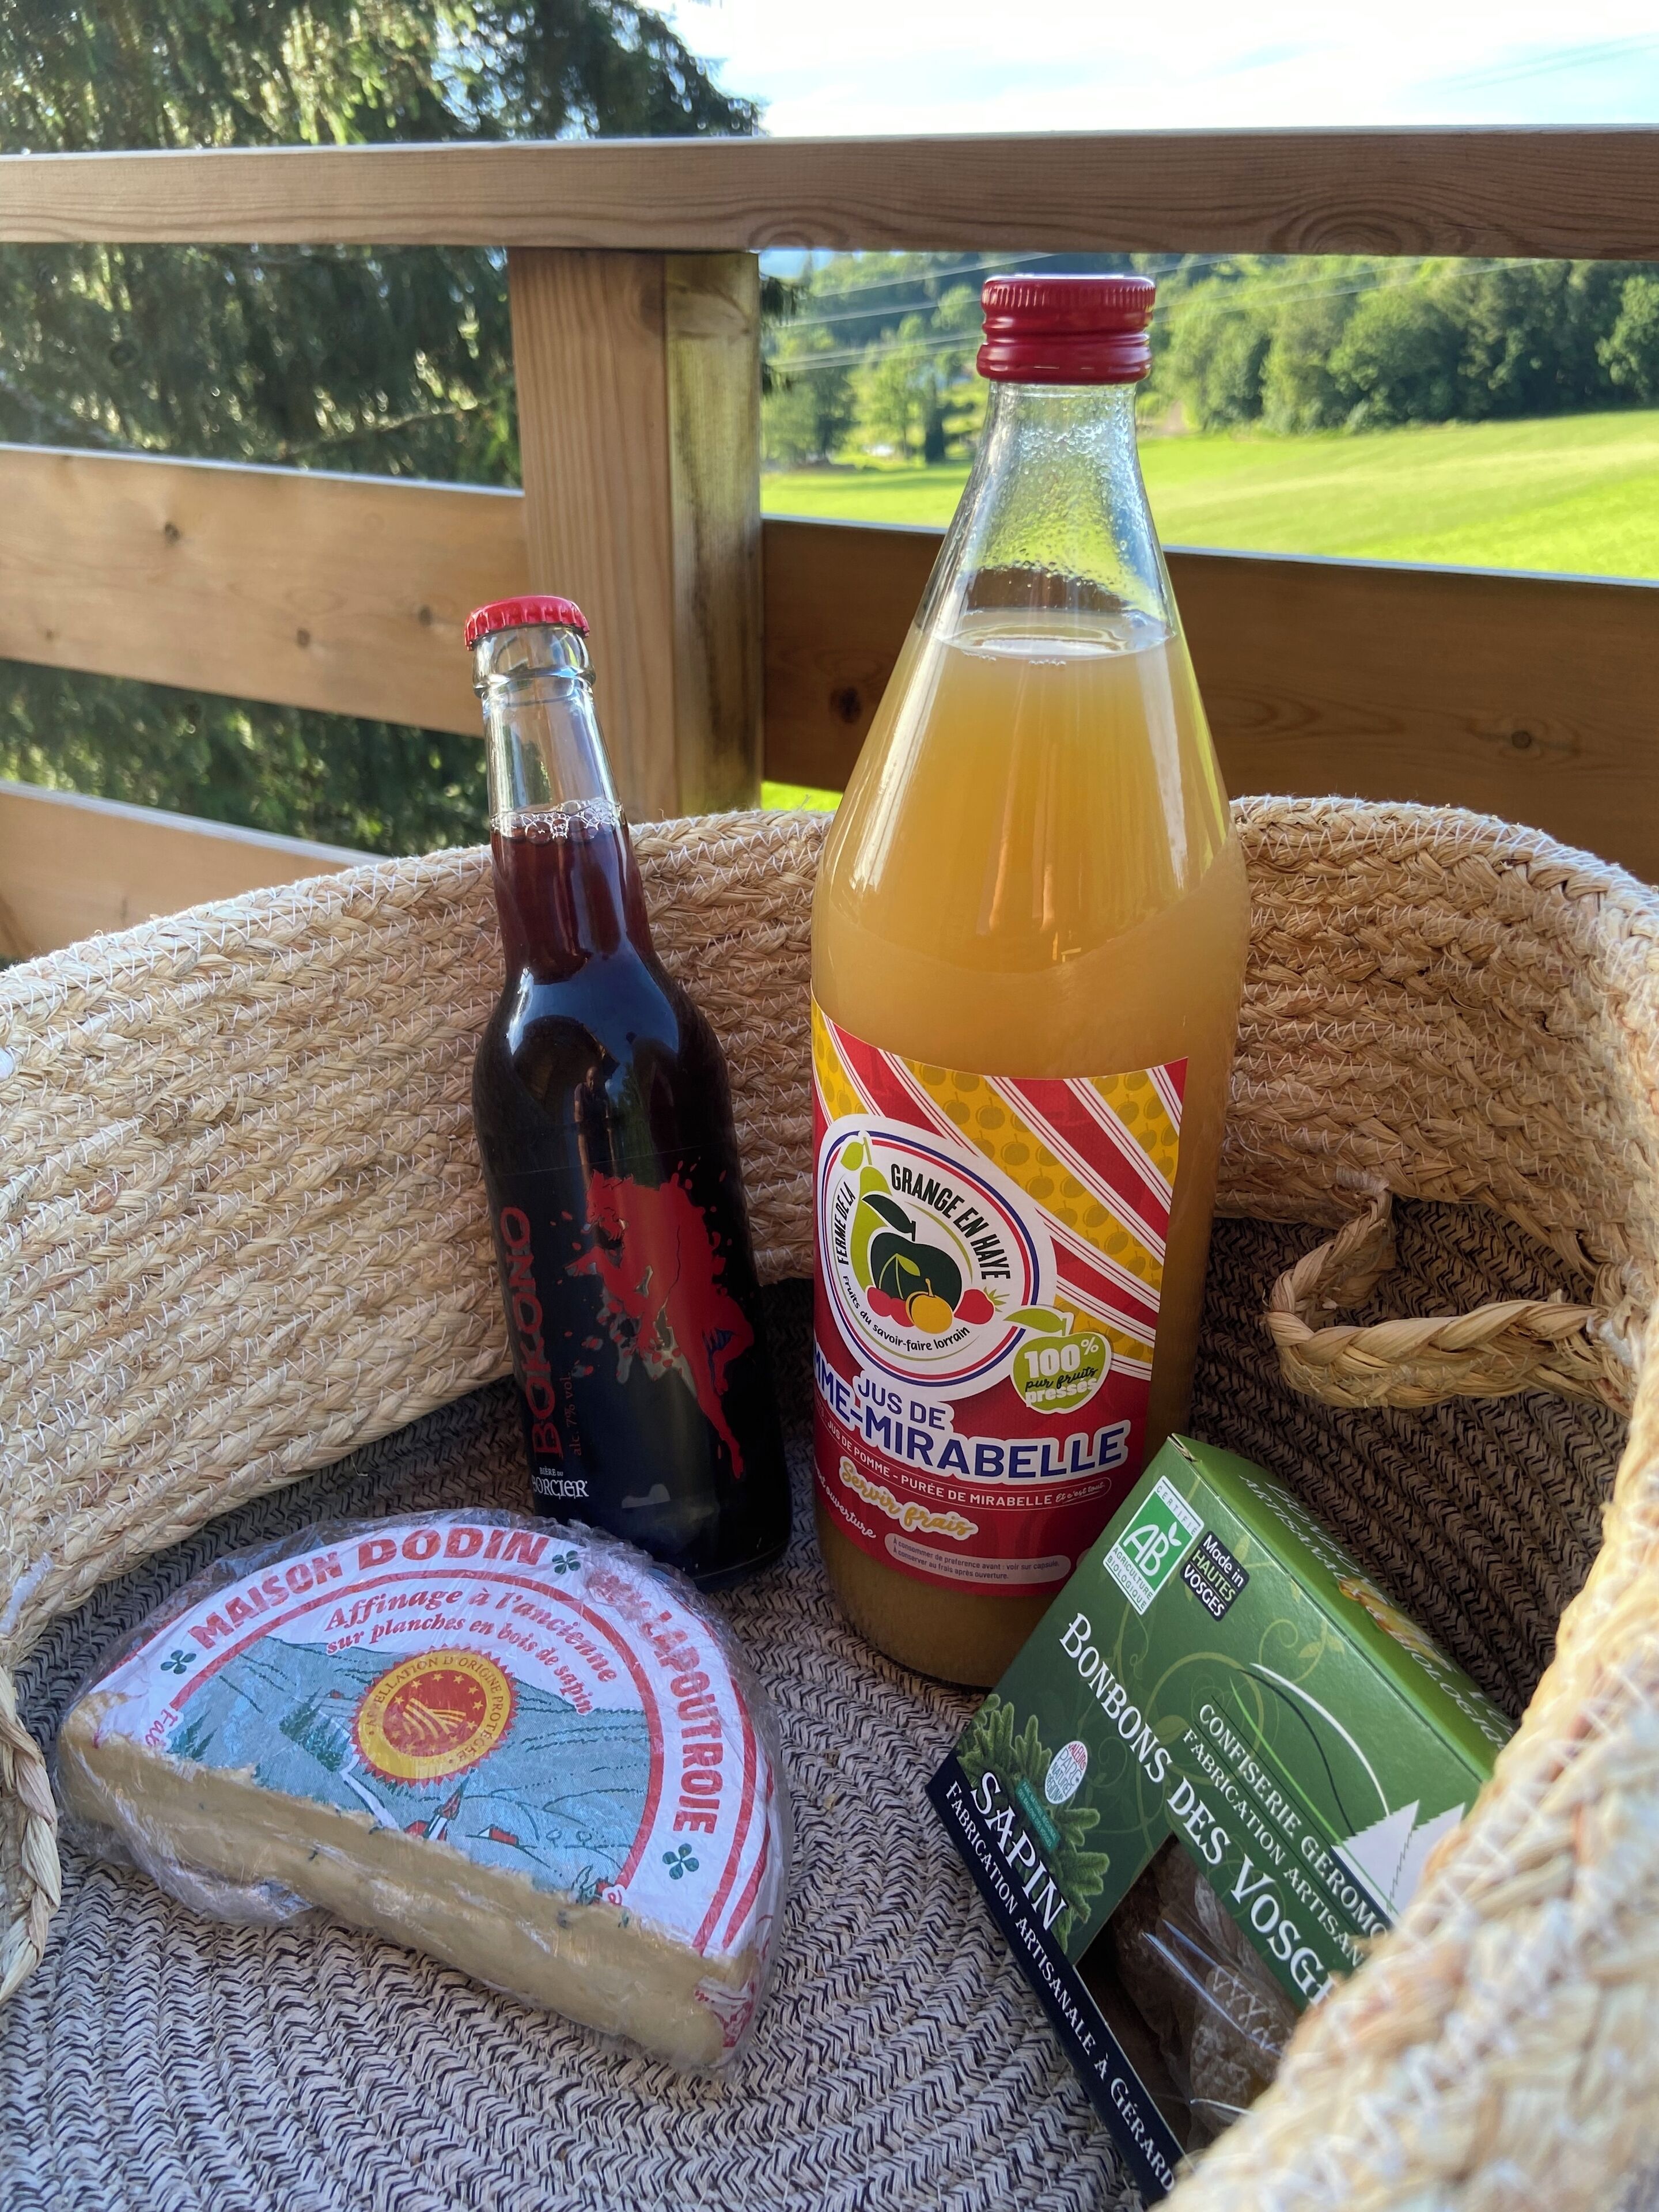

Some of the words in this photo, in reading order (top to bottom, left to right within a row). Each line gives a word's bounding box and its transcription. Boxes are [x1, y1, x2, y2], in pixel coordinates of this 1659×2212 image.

[835, 1195, 849, 1221] DE
[840, 1181, 855, 1206] LA
[891, 1164, 965, 1218] GRANGE
[835, 1214, 849, 1265] FERME
[953, 1207, 989, 1238] EN
[970, 1234, 1010, 1279] HAYE
[501, 1207, 563, 1459] BOKONO
[843, 1275, 860, 1309] Fruits
[860, 1310, 872, 1325] du
[873, 1324, 932, 1351] savoir-faire
[934, 1327, 970, 1349] lorrain
[1024, 1336, 1099, 1378] 100%
[1025, 1378, 1054, 1392] pur
[1056, 1366, 1099, 1389] fruits
[564, 1404, 577, 1427] 7%
[858, 1378, 902, 1415] JUS
[910, 1400, 946, 1430] DE
[1025, 1377, 1097, 1407] pressés
[531, 1474, 589, 1499] SORCIER
[539, 1465, 556, 1476] BIÈRE
[827, 1421, 840, 1440] JUS
[842, 1435, 852, 1452] DE
[854, 1447, 890, 1478] POMME
[901, 1474, 944, 1498] PURÉE
[948, 1490, 966, 1502] DE
[970, 1494, 1052, 1506] MIRABELLE
[826, 1486, 876, 1539] ouverture
[842, 1461, 901, 1514] Servir
[904, 1506, 974, 1536] frais
[1055, 1493, 1066, 1503] Et
[1067, 1488, 1087, 1499] c'est
[893, 1536, 897, 1544] À
[899, 1541, 933, 1558] consommer
[893, 1545, 897, 1554] À
[898, 1551, 927, 1565] conserver
[938, 1563, 953, 1573] frais
[955, 1569, 974, 1577] après
[1122, 1524, 1171, 1577] AB
[1202, 1535, 1232, 1573] Made
[1231, 1569, 1245, 1587] in
[1264, 1482, 1395, 1607] BONBONS
[187, 1551, 343, 1650] MAISON
[357, 1527, 550, 1571] DODIN
[1106, 1555, 1147, 1611] BIOLOGIQUE
[1112, 1546, 1153, 1600] AGRICULTURE
[1183, 1565, 1226, 1618] VOSGES
[1192, 1550, 1236, 1603] HAUTES
[324, 1590, 463, 1631] Affinage
[468, 1587, 490, 1605] à
[495, 1592, 617, 1681] l'ancienne
[327, 1631, 364, 1654] sur
[370, 1613, 465, 1644] planches
[469, 1620, 494, 1635] en
[498, 1623, 537, 1652] bois
[535, 1647, 558, 1665] de
[554, 1665, 593, 1714] sapin
[1059, 1613, 1172, 1782] BONBONS
[1167, 1778, 1230, 1865] DES
[1068, 1744, 1086, 1770] VALEURS
[1051, 1762, 1072, 1797] NATUREL
[1058, 1748, 1082, 1786] PARC
[1199, 1703, 1309, 1839] CONFISERIE
[1183, 1728, 1286, 1866] FABRICATION
[970, 1771, 1067, 1931] SAPIN
[945, 1779, 1018, 1915] FABRICATION
[1016, 1916, 1096, 2056] ARTISANALE
[1094, 2051, 1108, 2075] À
